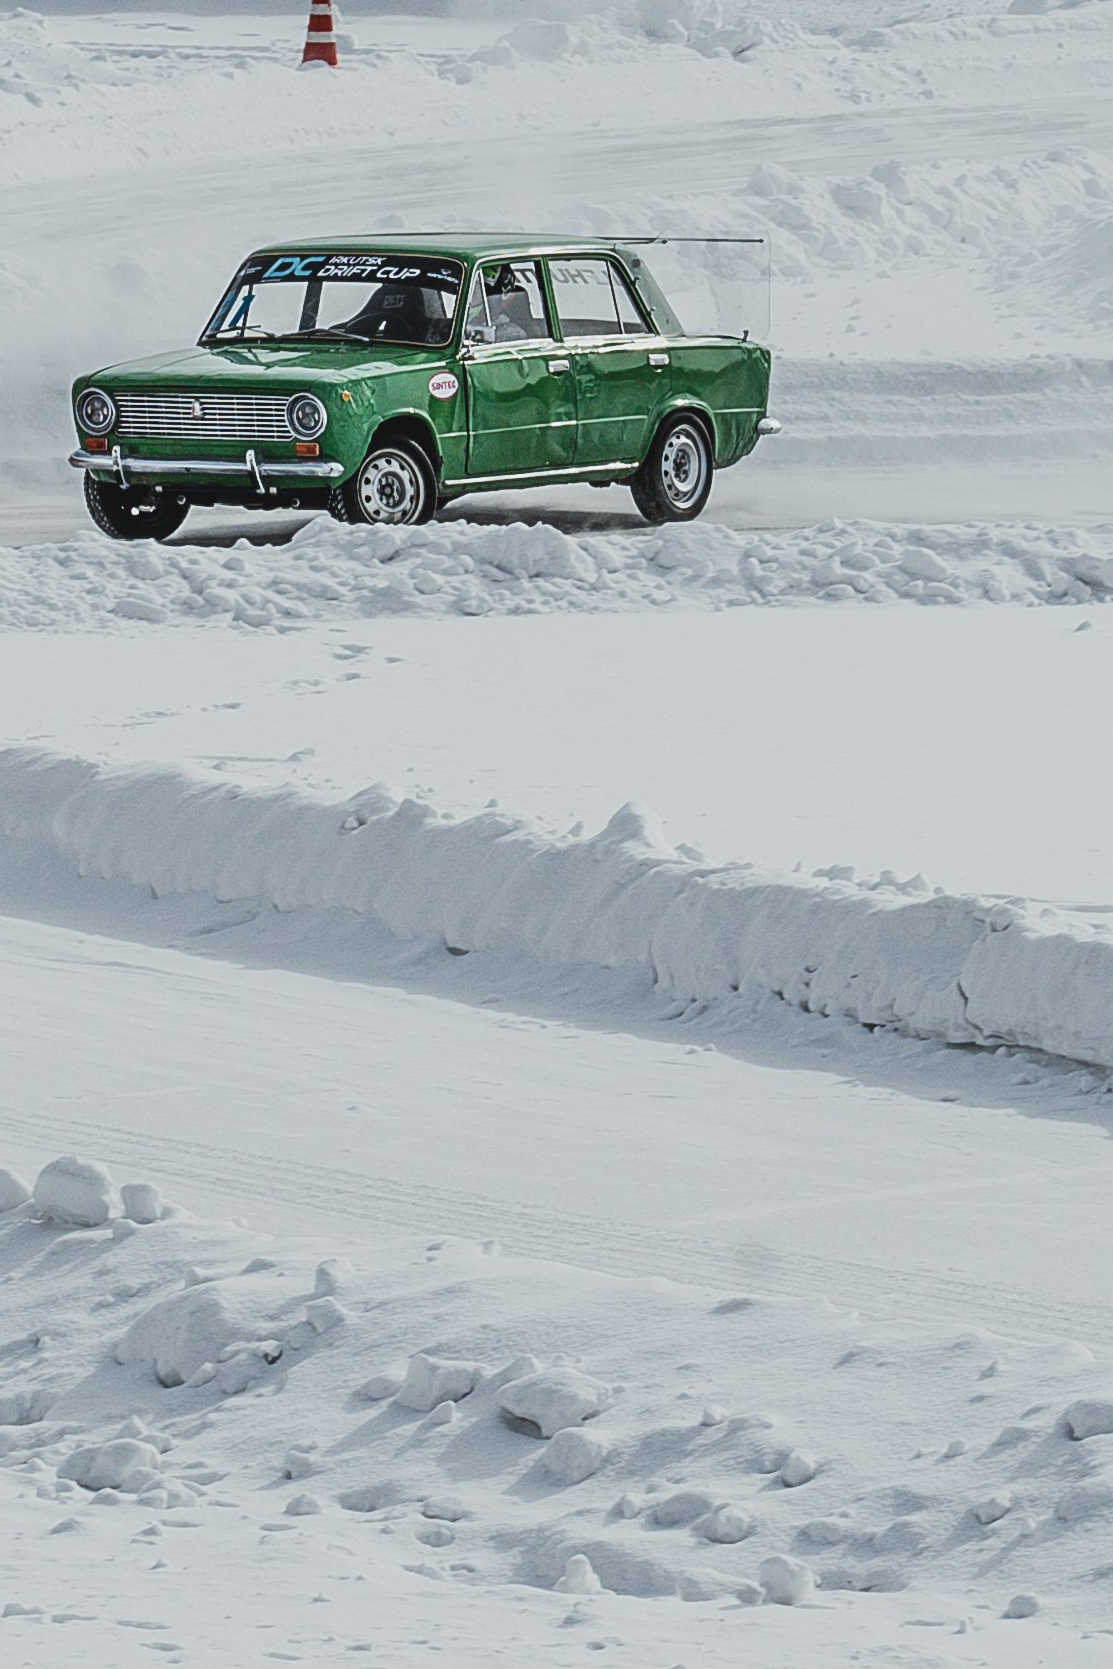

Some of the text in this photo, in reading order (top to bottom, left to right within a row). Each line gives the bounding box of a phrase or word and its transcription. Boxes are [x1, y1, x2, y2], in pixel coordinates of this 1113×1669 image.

[328, 255, 387, 265] IRKUTSK
[262, 256, 327, 278] DC
[316, 265, 378, 277] DRIFT
[376, 266, 421, 279] CUP
[431, 380, 456, 391] SINTEC
